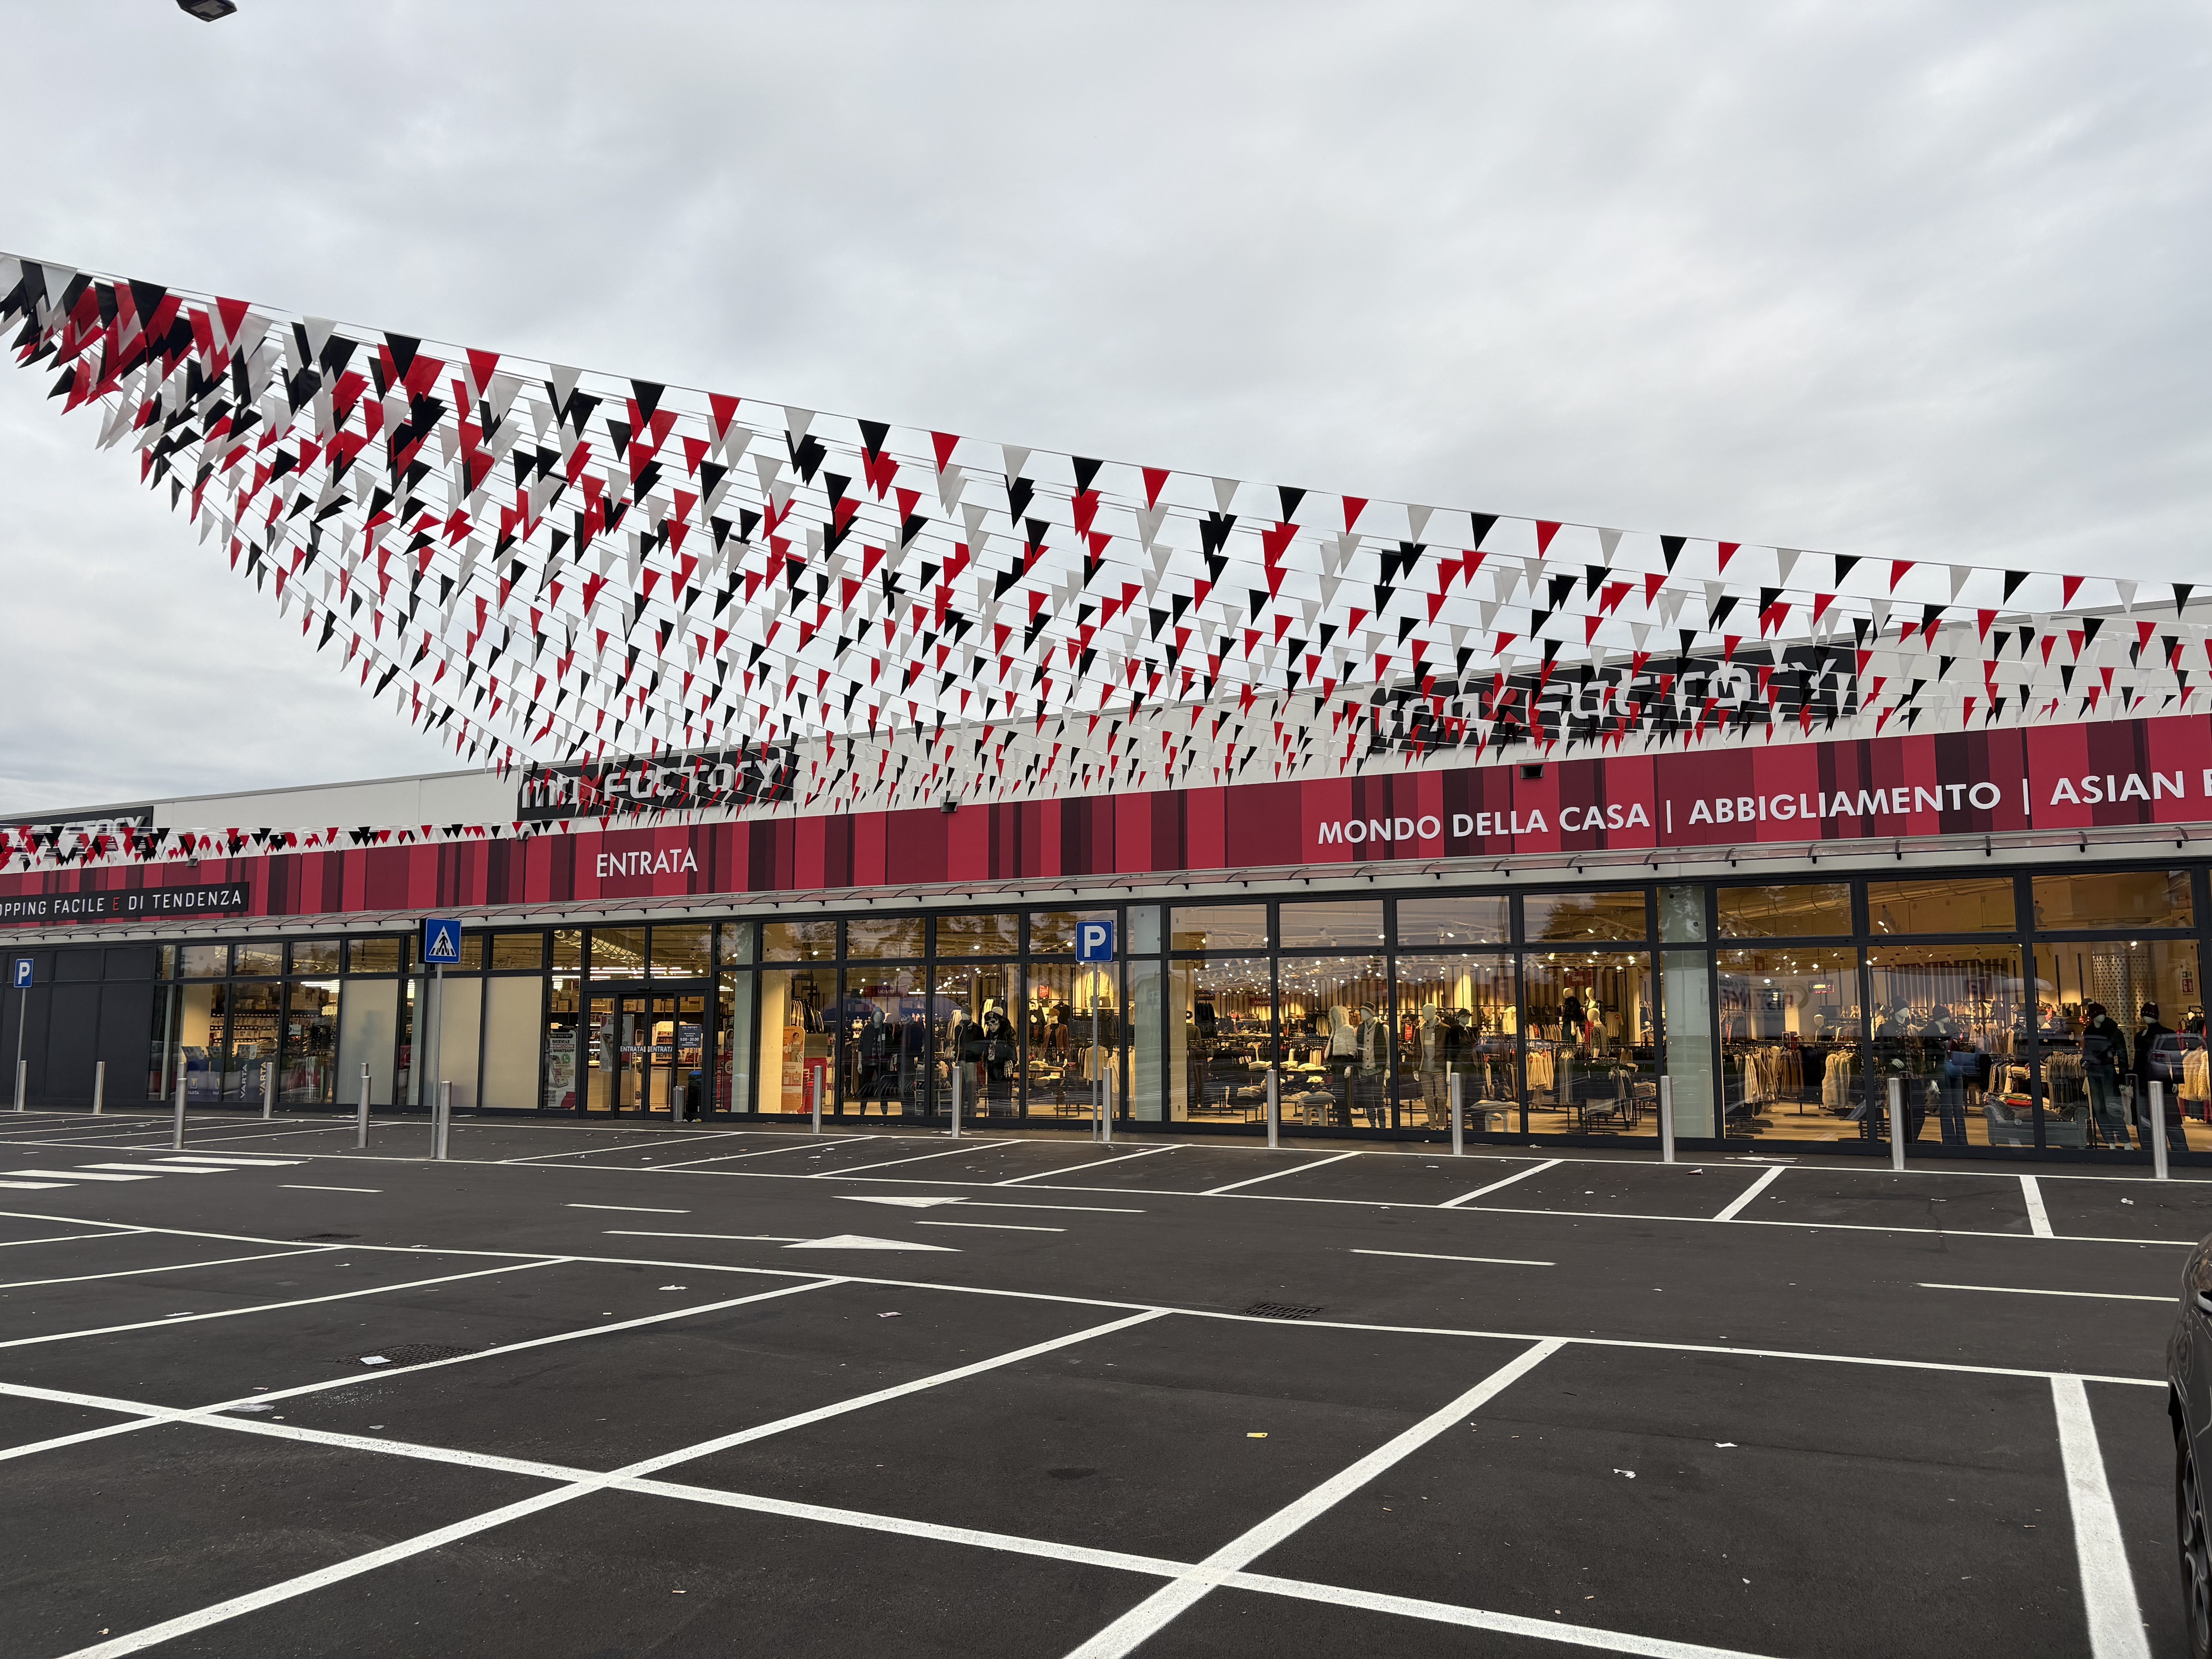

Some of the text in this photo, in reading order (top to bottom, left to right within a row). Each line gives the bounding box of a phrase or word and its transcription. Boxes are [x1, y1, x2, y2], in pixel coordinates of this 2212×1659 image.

[1318, 816, 1441, 844] MONDO
[1453, 809, 1549, 837] DELLA
[1559, 803, 1650, 831] CASA
[1688, 782, 2001, 824] ABBIGLIAMENTO
[2050, 771, 2185, 805] ASIAN
[597, 847, 698, 878] ENTRATA
[54, 898, 105, 914] FACILE
[113, 897, 120, 910] E
[129, 895, 144, 910] DI
[152, 890, 241, 908] TENDENZA
[1084, 926, 1106, 957] P
[18, 962, 30, 984] P
